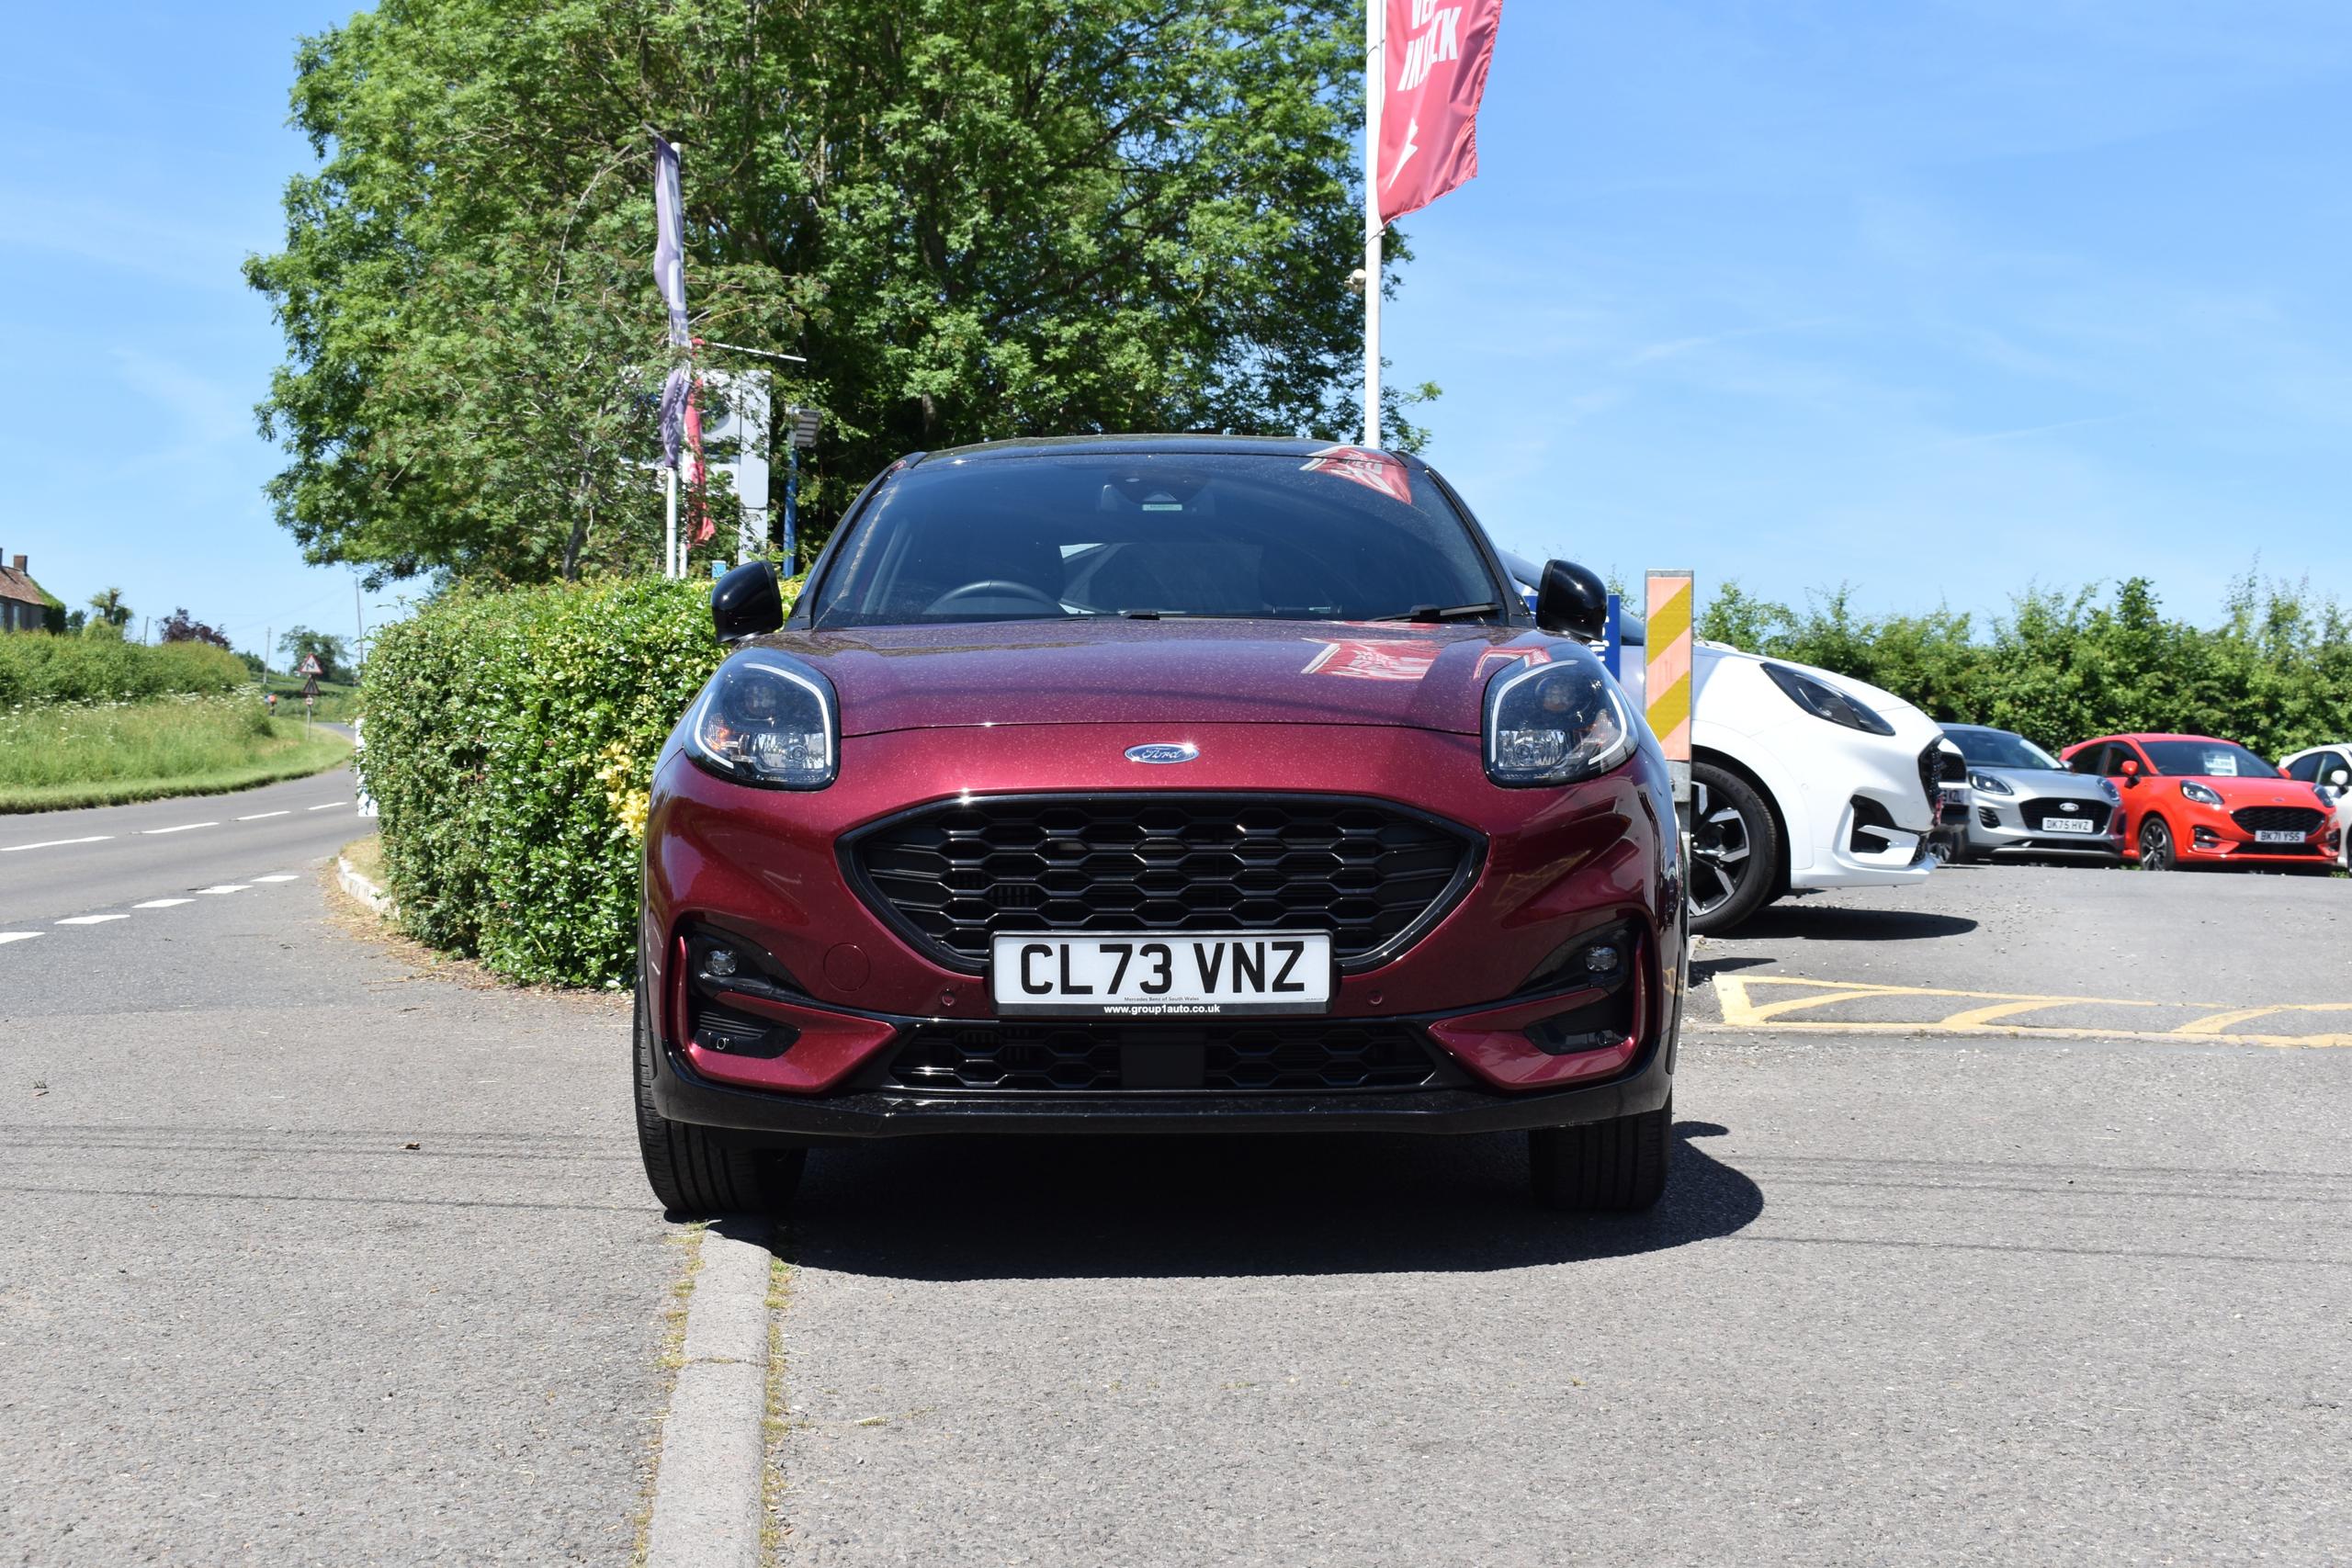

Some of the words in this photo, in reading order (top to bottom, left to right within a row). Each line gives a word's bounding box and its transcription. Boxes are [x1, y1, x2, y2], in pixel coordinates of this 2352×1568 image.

[1142, 747, 1182, 759] Ford
[2283, 831, 2301, 841] YSS
[1021, 943, 1172, 995] CL73
[1193, 941, 1305, 993] VNZ
[1103, 1004, 1220, 1015] www.group1auto.co.uk
